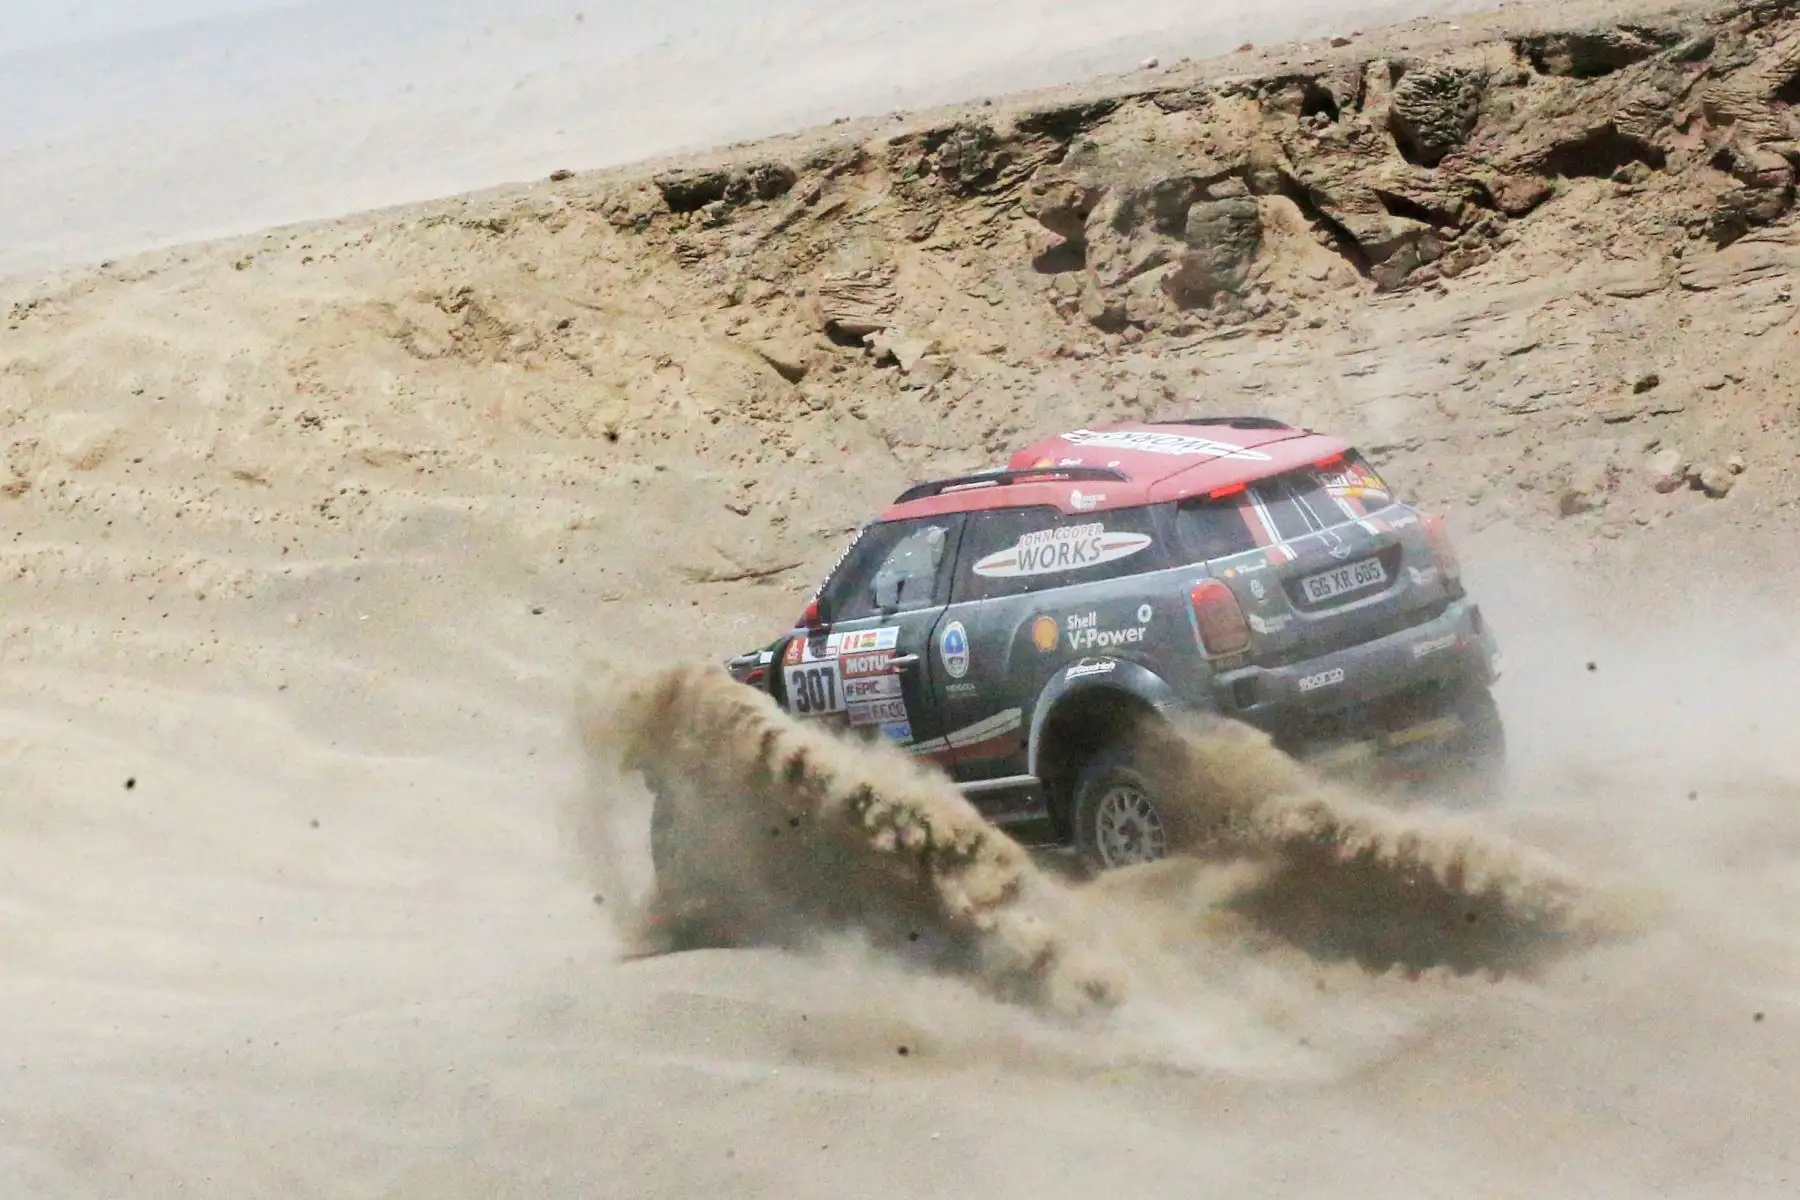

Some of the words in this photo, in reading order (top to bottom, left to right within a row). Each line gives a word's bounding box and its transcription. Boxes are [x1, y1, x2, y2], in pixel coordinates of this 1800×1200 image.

[1020, 530, 1052, 548] JOHN
[1055, 523, 1103, 541] COOPER
[1017, 537, 1103, 571] WORKS
[1067, 610, 1096, 629] Shell
[1068, 627, 1146, 651] V-Power
[792, 667, 836, 713] 307
